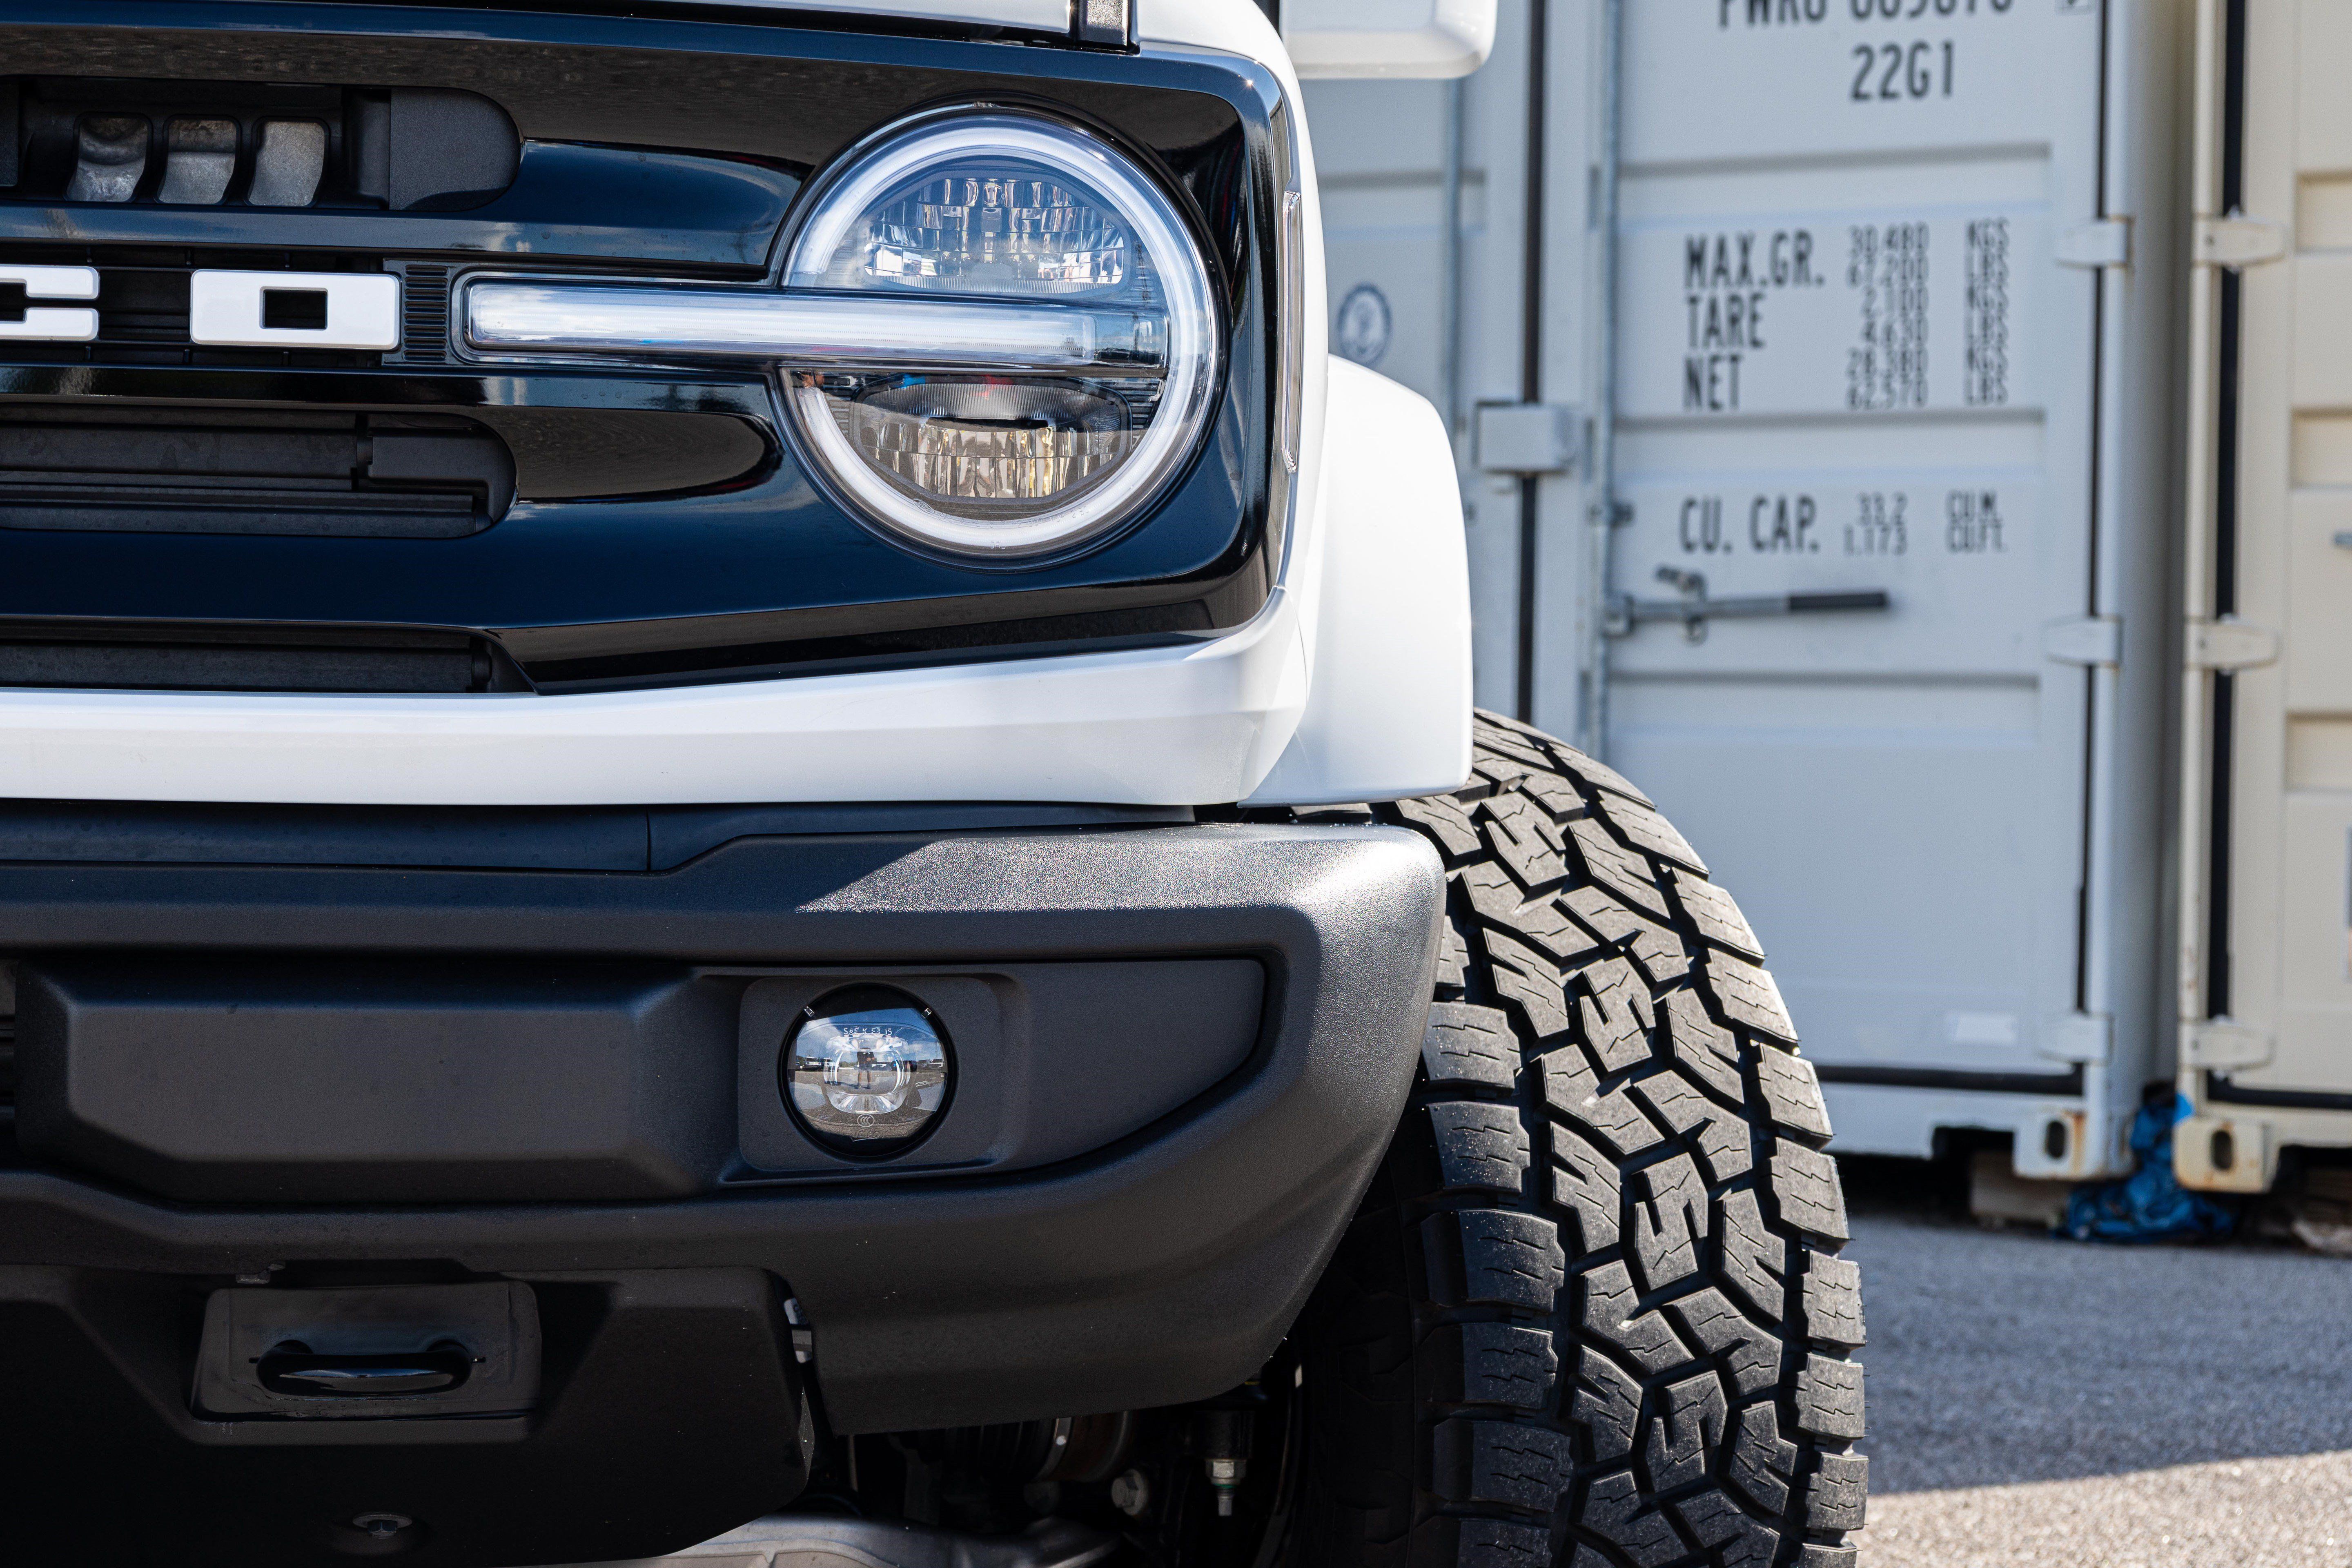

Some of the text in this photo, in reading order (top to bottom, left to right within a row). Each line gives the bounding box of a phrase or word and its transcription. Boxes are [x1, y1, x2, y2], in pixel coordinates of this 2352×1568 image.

[1851, 40, 1954, 101] 22G1
[1684, 230, 1825, 289] MAX.GR.
[1687, 292, 1766, 349] TARE
[1684, 354, 1742, 411] NET
[1679, 495, 1732, 554] CU.
[1750, 494, 1820, 553] CAP.
